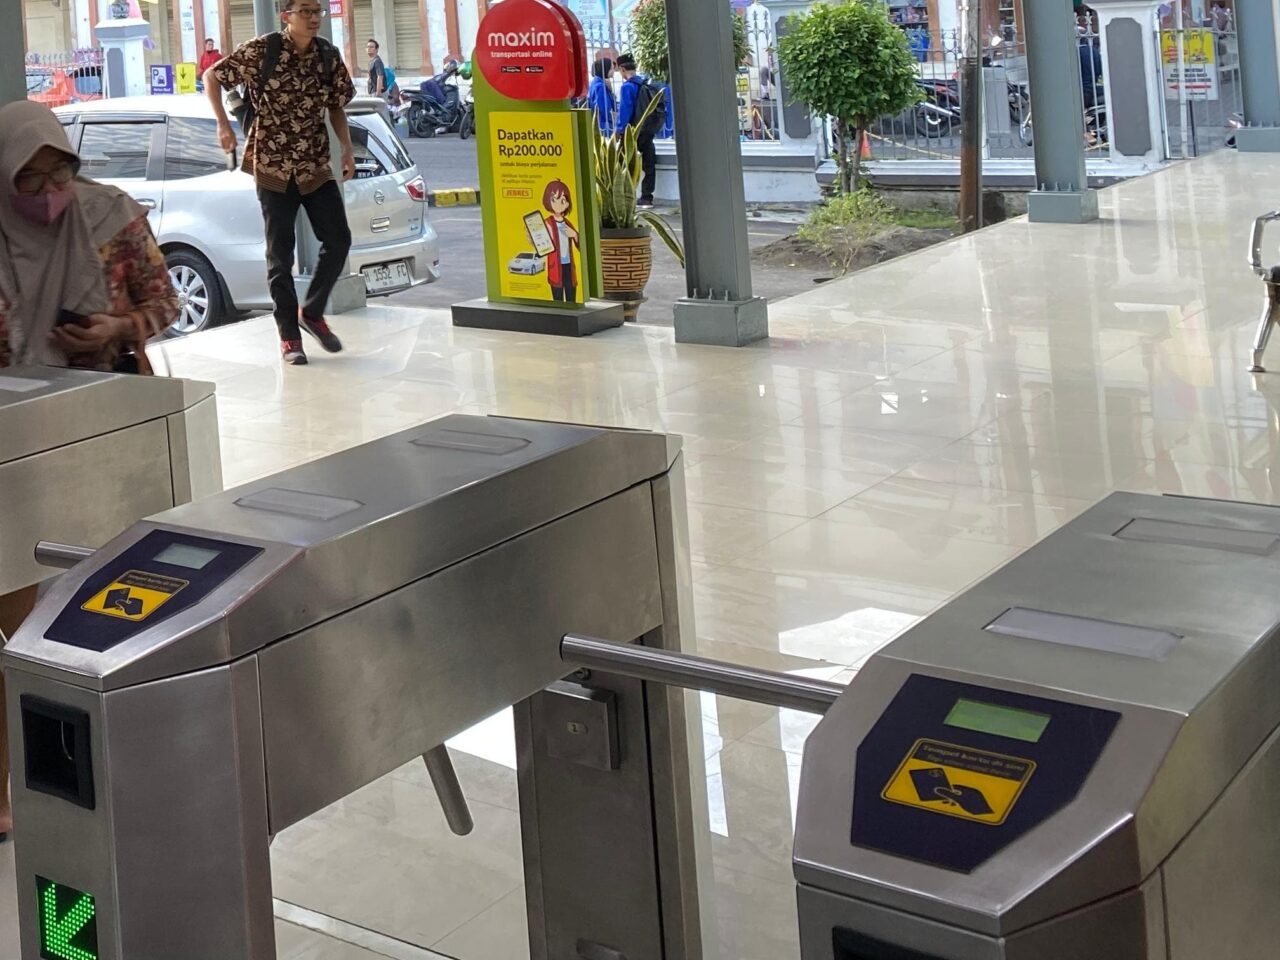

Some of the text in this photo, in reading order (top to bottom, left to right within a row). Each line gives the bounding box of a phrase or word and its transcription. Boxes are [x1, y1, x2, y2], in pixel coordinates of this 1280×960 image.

[488, 27, 555, 47] maxim
[490, 51, 530, 59] transportasi
[497, 129, 554, 142] Dapatkan
[498, 144, 563, 158] Rp200.000
